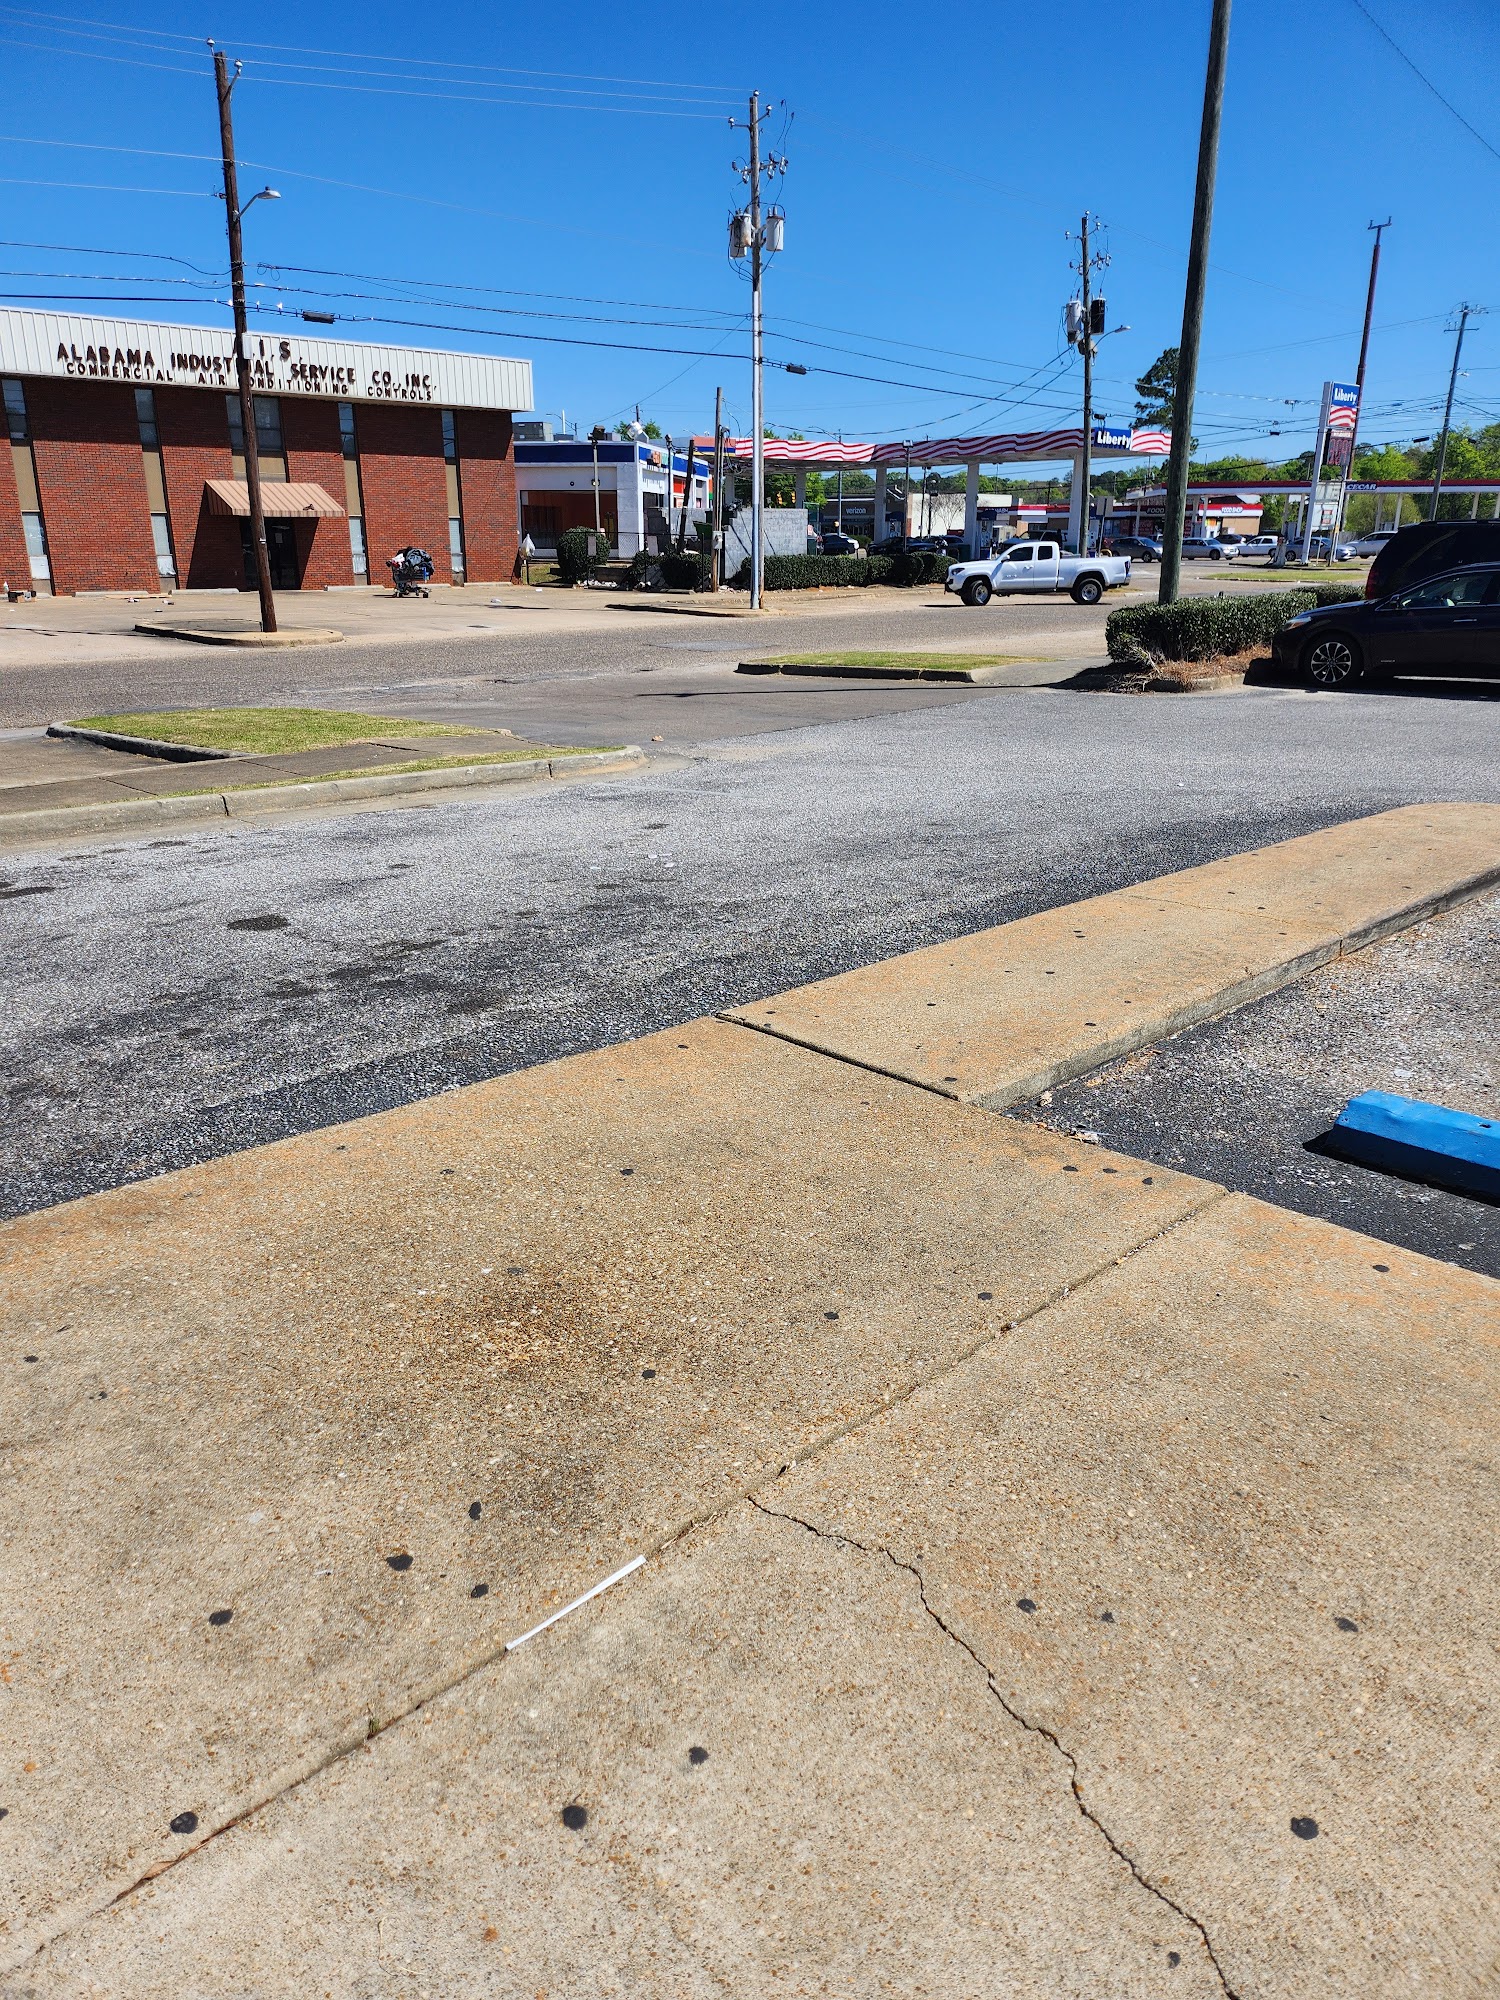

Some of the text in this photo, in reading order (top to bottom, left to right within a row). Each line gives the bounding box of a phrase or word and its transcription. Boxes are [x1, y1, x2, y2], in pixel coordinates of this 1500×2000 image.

[57, 342, 155, 368] ALABAMA
[171, 352, 275, 377] INDUSTIAL
[290, 363, 356, 384] SERVICE
[66, 362, 432, 401] COMMERCIAL AIR ONDITIONING CONTROLS
[1334, 387, 1357, 405] Liberty
[1097, 430, 1131, 449] Liberty
[846, 506, 866, 514] verizon
